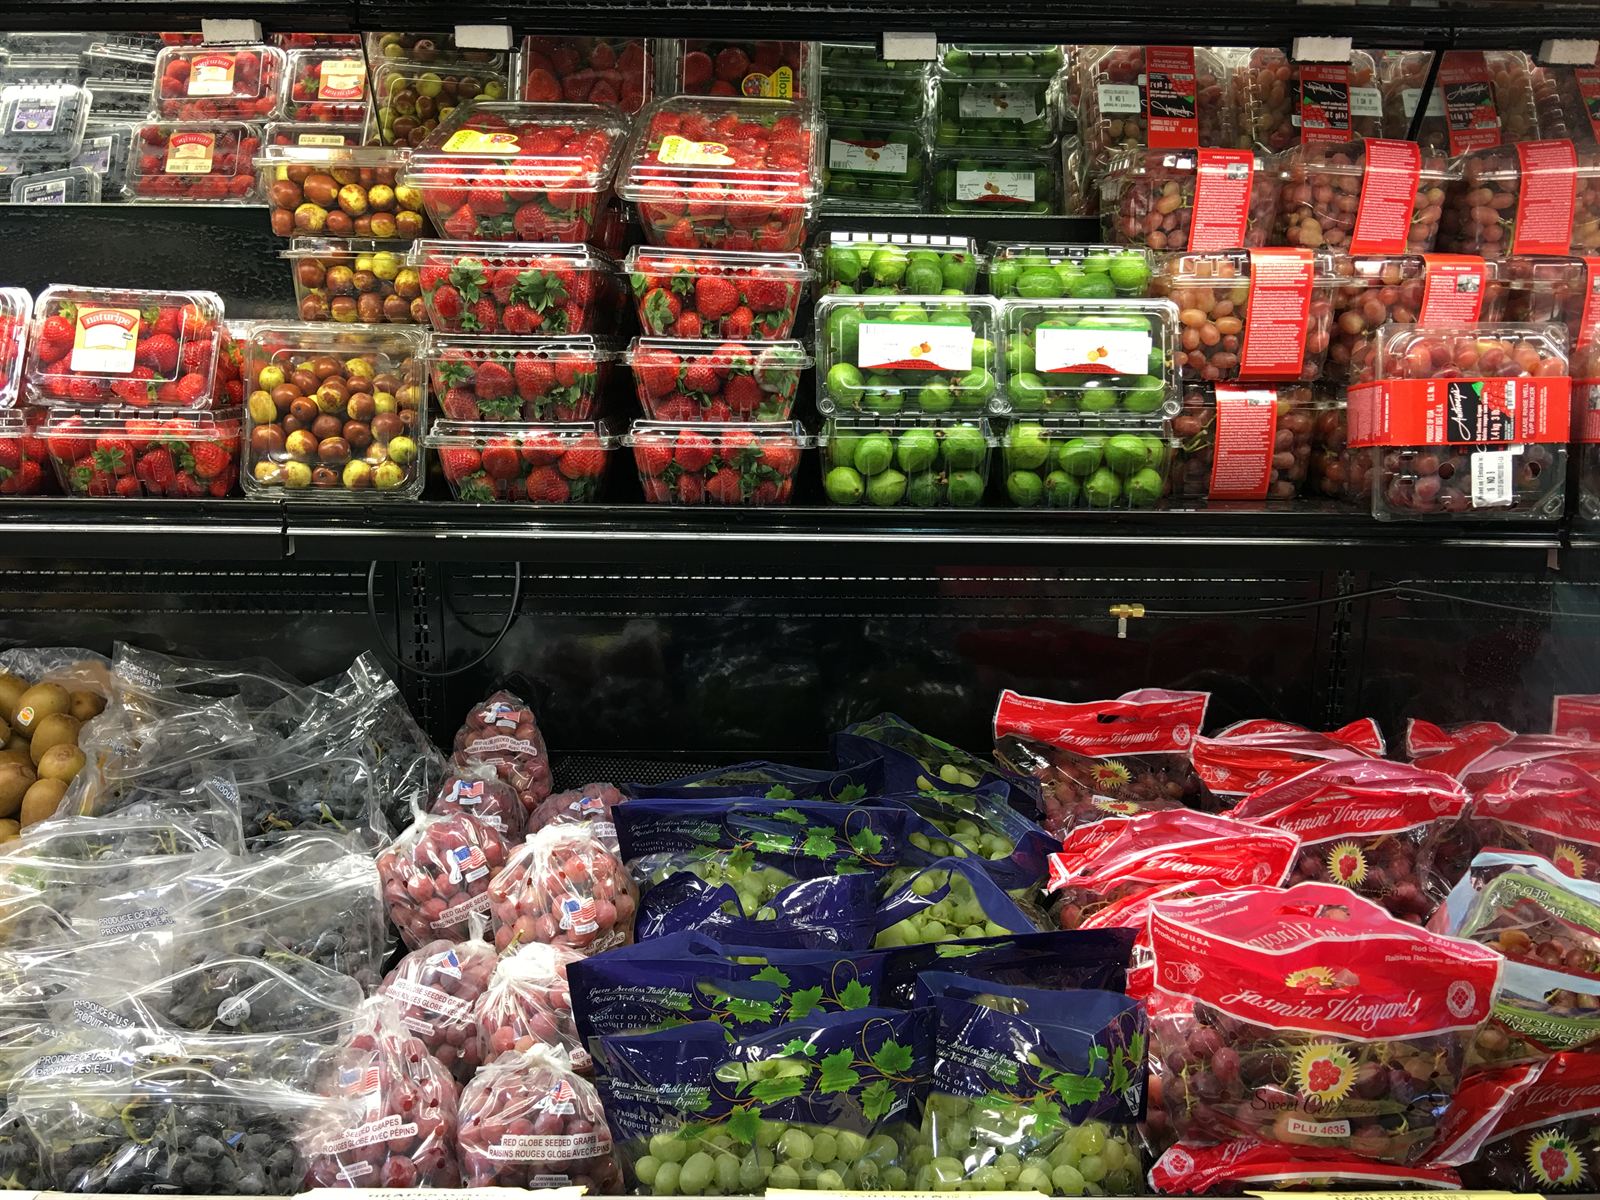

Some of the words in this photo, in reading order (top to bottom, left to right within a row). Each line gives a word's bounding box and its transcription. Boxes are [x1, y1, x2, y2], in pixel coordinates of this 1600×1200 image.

[86, 312, 131, 325] naturipe
[1276, 810, 1335, 833] Jasmine
[441, 910, 454, 919] RED
[454, 902, 473, 914] GLOBE
[98, 912, 134, 927] PRODUCE
[136, 910, 146, 919] OF
[100, 924, 136, 937] PRODUIT
[138, 920, 152, 930] DES
[1154, 918, 1181, 936] Produce
[1153, 929, 1176, 946] Produit
[1384, 954, 1411, 963] Raisins
[424, 990, 448, 1003] SEEDED
[587, 987, 610, 1000] Green
[74, 1000, 108, 1017] PRODUCE
[108, 1012, 117, 1020] OF
[421, 999, 442, 1012] GLOBE
[1219, 986, 1322, 1021] Jasmine
[1323, 990, 1421, 1032] Vineyards
[74, 1009, 104, 1028] PRODUIT
[38, 1053, 80, 1065] PRODUCE
[80, 1052, 92, 1062] OF
[948, 1040, 979, 1056] Seedless
[980, 1047, 998, 1060] Table
[999, 1052, 1020, 1068] Grapes
[950, 1052, 967, 1065] Verts
[968, 1059, 987, 1070] Sans
[74, 1064, 91, 1075] DES
[609, 1077, 630, 1089] Green
[631, 1082, 658, 1093] Seedless
[660, 1083, 681, 1094] Table
[684, 1082, 711, 1095] Grapes
[952, 1088, 965, 1096] DES
[1250, 1089, 1299, 1111] Sweet
[617, 1109, 647, 1122] PRODUCE
[372, 1117, 400, 1132] GRAPES
[619, 1118, 648, 1131] PRODUIT
[650, 1126, 663, 1134] DES
[1293, 1122, 1317, 1133] PLU
[1320, 1123, 1346, 1134] 4635
[369, 1131, 389, 1142] AVEC
[503, 1138, 516, 1146] RED
[518, 1138, 543, 1146] GLOBE
[544, 1138, 571, 1146] SEEDED
[573, 1136, 596, 1145] GRAPES
[489, 1149, 514, 1157] RAISINS
[547, 1150, 571, 1158] GLOBE
